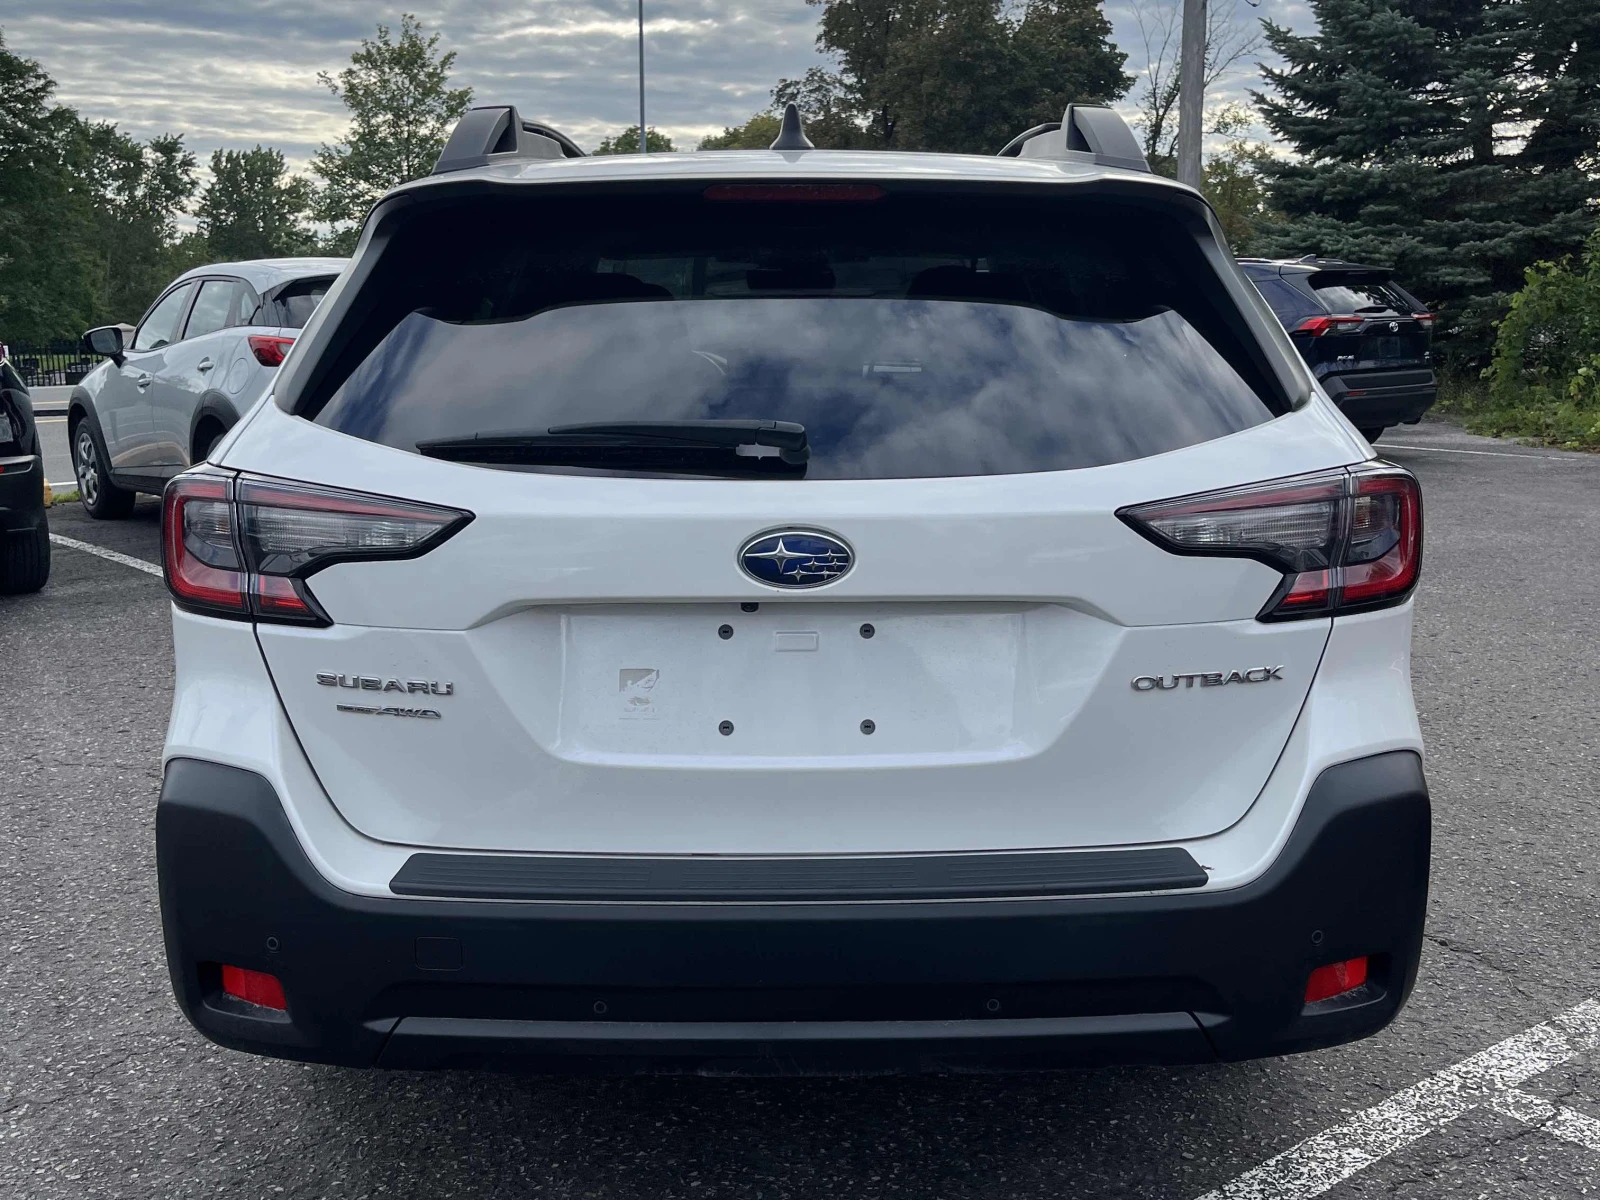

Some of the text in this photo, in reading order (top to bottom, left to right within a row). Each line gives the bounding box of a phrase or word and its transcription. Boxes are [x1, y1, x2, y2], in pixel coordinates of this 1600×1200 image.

[316, 671, 454, 696] SUBARU
[1131, 664, 1284, 691] OUTBACK
[376, 707, 442, 720] AWD
